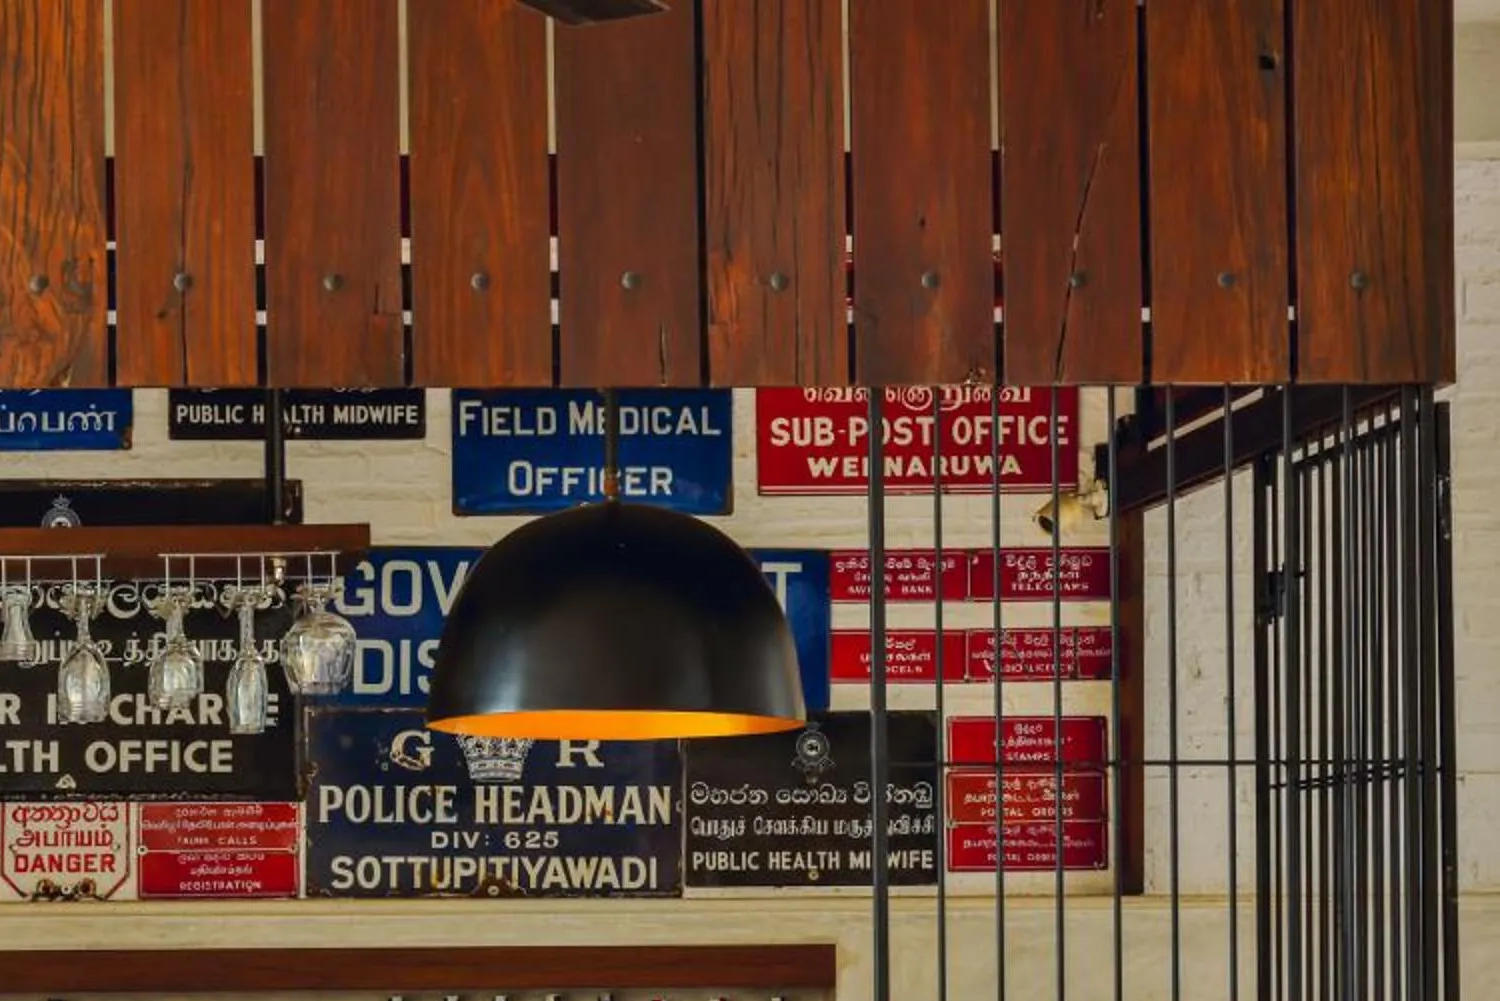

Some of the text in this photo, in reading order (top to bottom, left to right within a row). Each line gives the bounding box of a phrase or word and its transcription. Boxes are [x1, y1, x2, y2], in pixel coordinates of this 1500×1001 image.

[177, 405, 244, 424] PUBLIC
[333, 405, 418, 424] MIDWIFE
[953, 415, 1069, 446] OFFICE
[84, 740, 233, 773] OFFICE
[389, 729, 434, 771] G
[319, 785, 458, 824] POLICE
[474, 785, 672, 826] HEADMAN
[217, 835, 258, 845] CALLS
[504, 831, 560, 849] 625
[14, 853, 116, 873] DANGER
[331, 855, 658, 890] SOTTUPITIYAWADI
[692, 849, 934, 871] PUBLIC HEALTH MIWIFE
